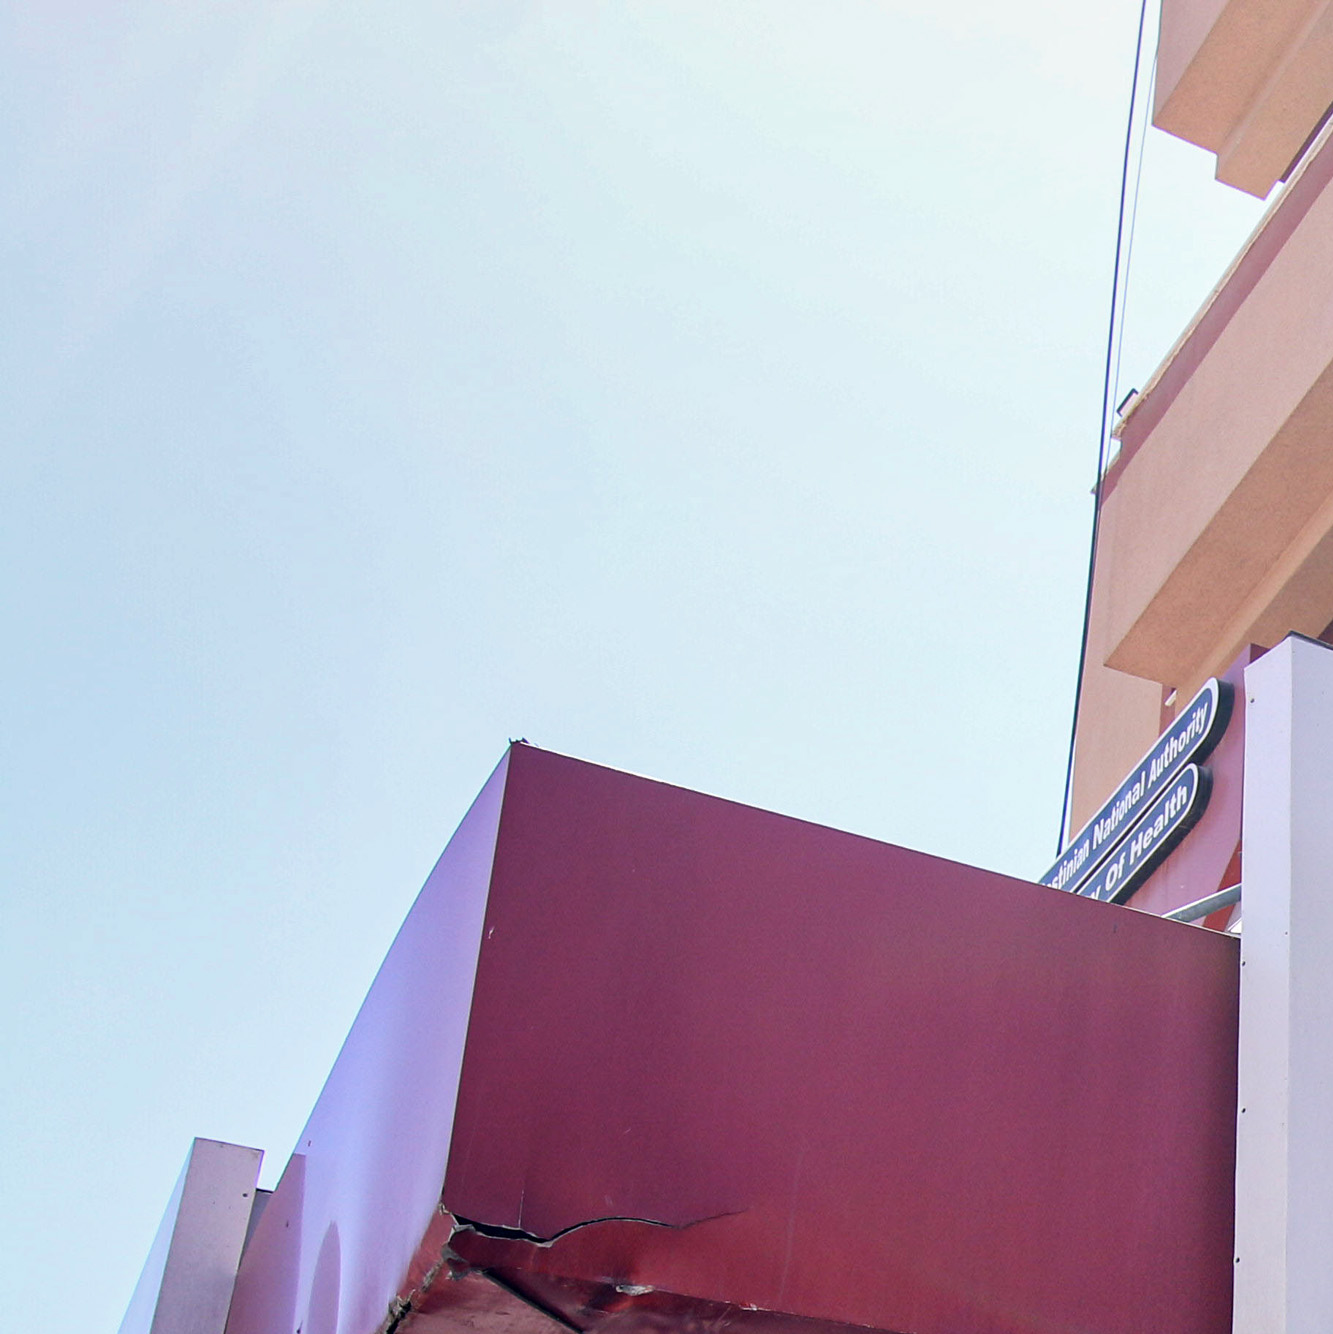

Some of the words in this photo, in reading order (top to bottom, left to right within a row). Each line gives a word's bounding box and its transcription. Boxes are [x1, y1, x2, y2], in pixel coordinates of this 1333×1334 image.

[1092, 770, 1145, 850] National
[1147, 702, 1209, 788] Authority
[1105, 852, 1125, 890] Of
[1129, 783, 1188, 866] Health
